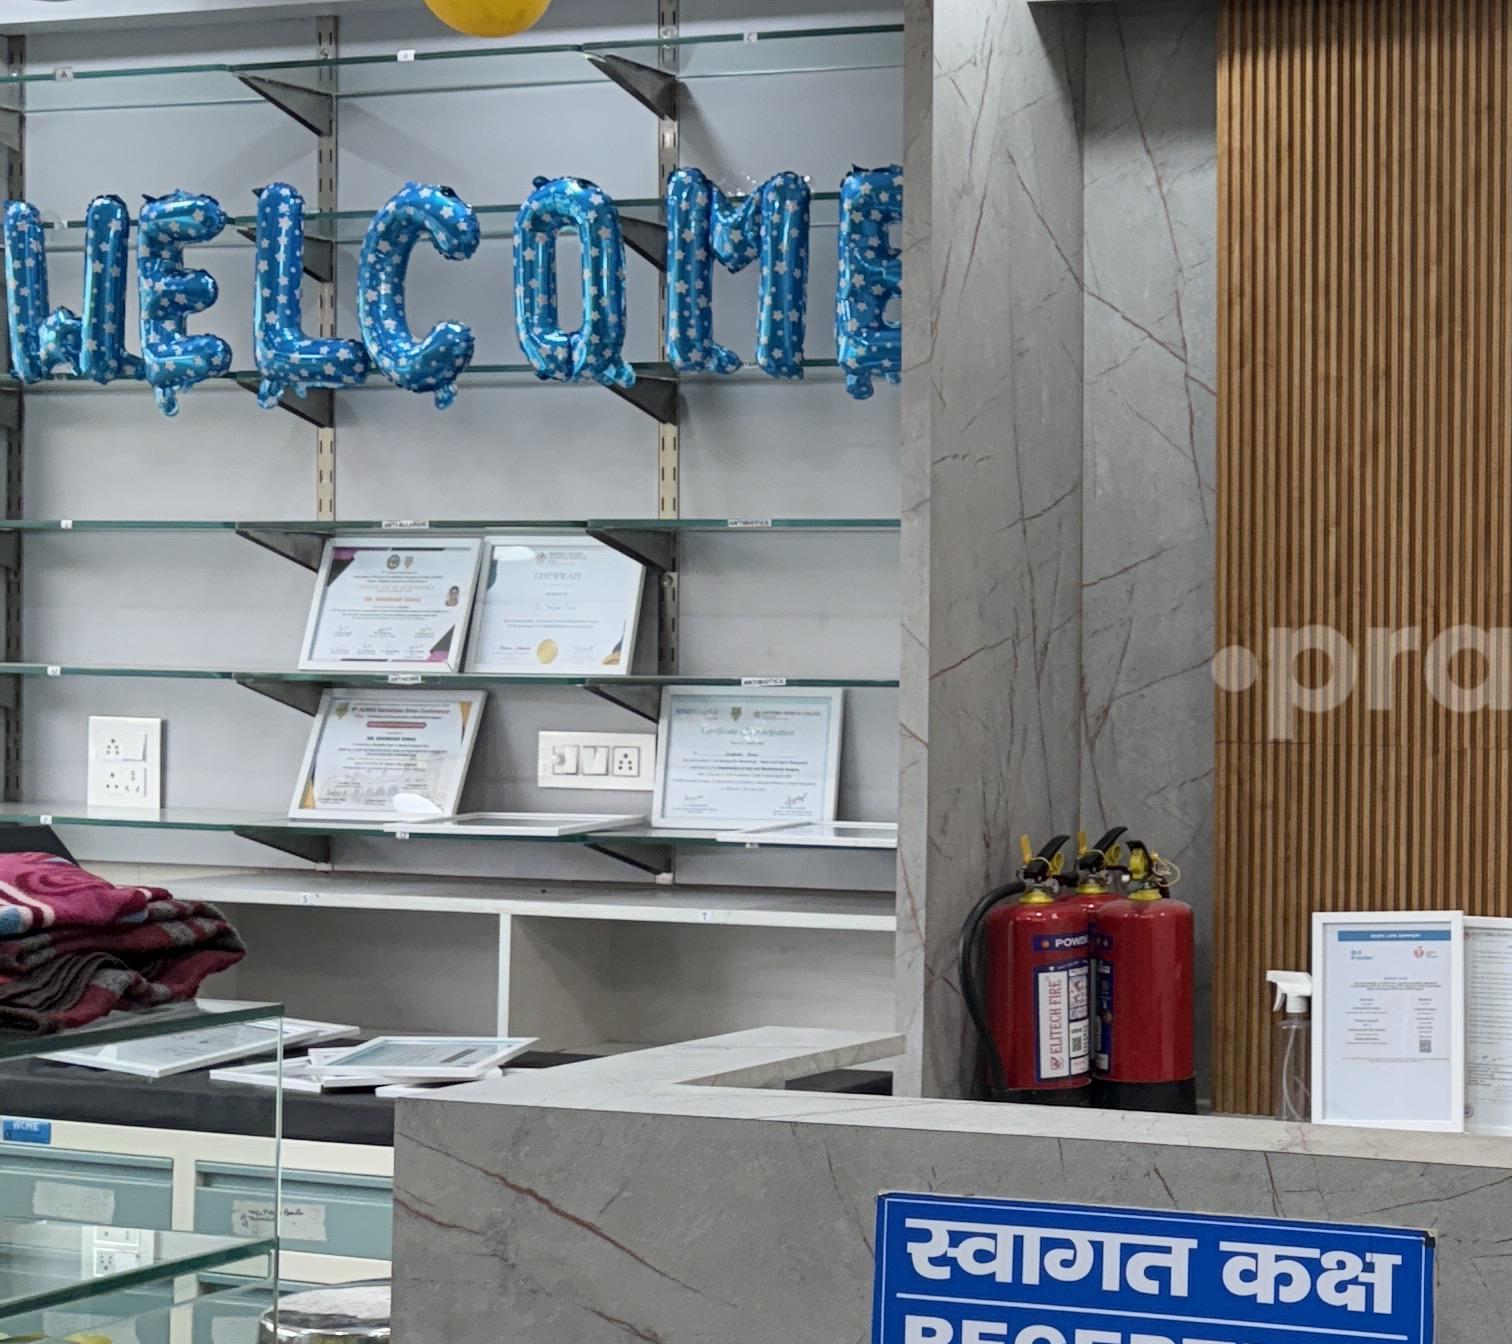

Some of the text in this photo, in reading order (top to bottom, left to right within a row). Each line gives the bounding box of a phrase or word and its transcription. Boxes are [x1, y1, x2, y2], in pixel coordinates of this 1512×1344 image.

[3, 163, 904, 404] WELCOME
[1049, 979, 1062, 1007] FIRE
[905, 1217, 1403, 1315] स्वागत कक्ष
